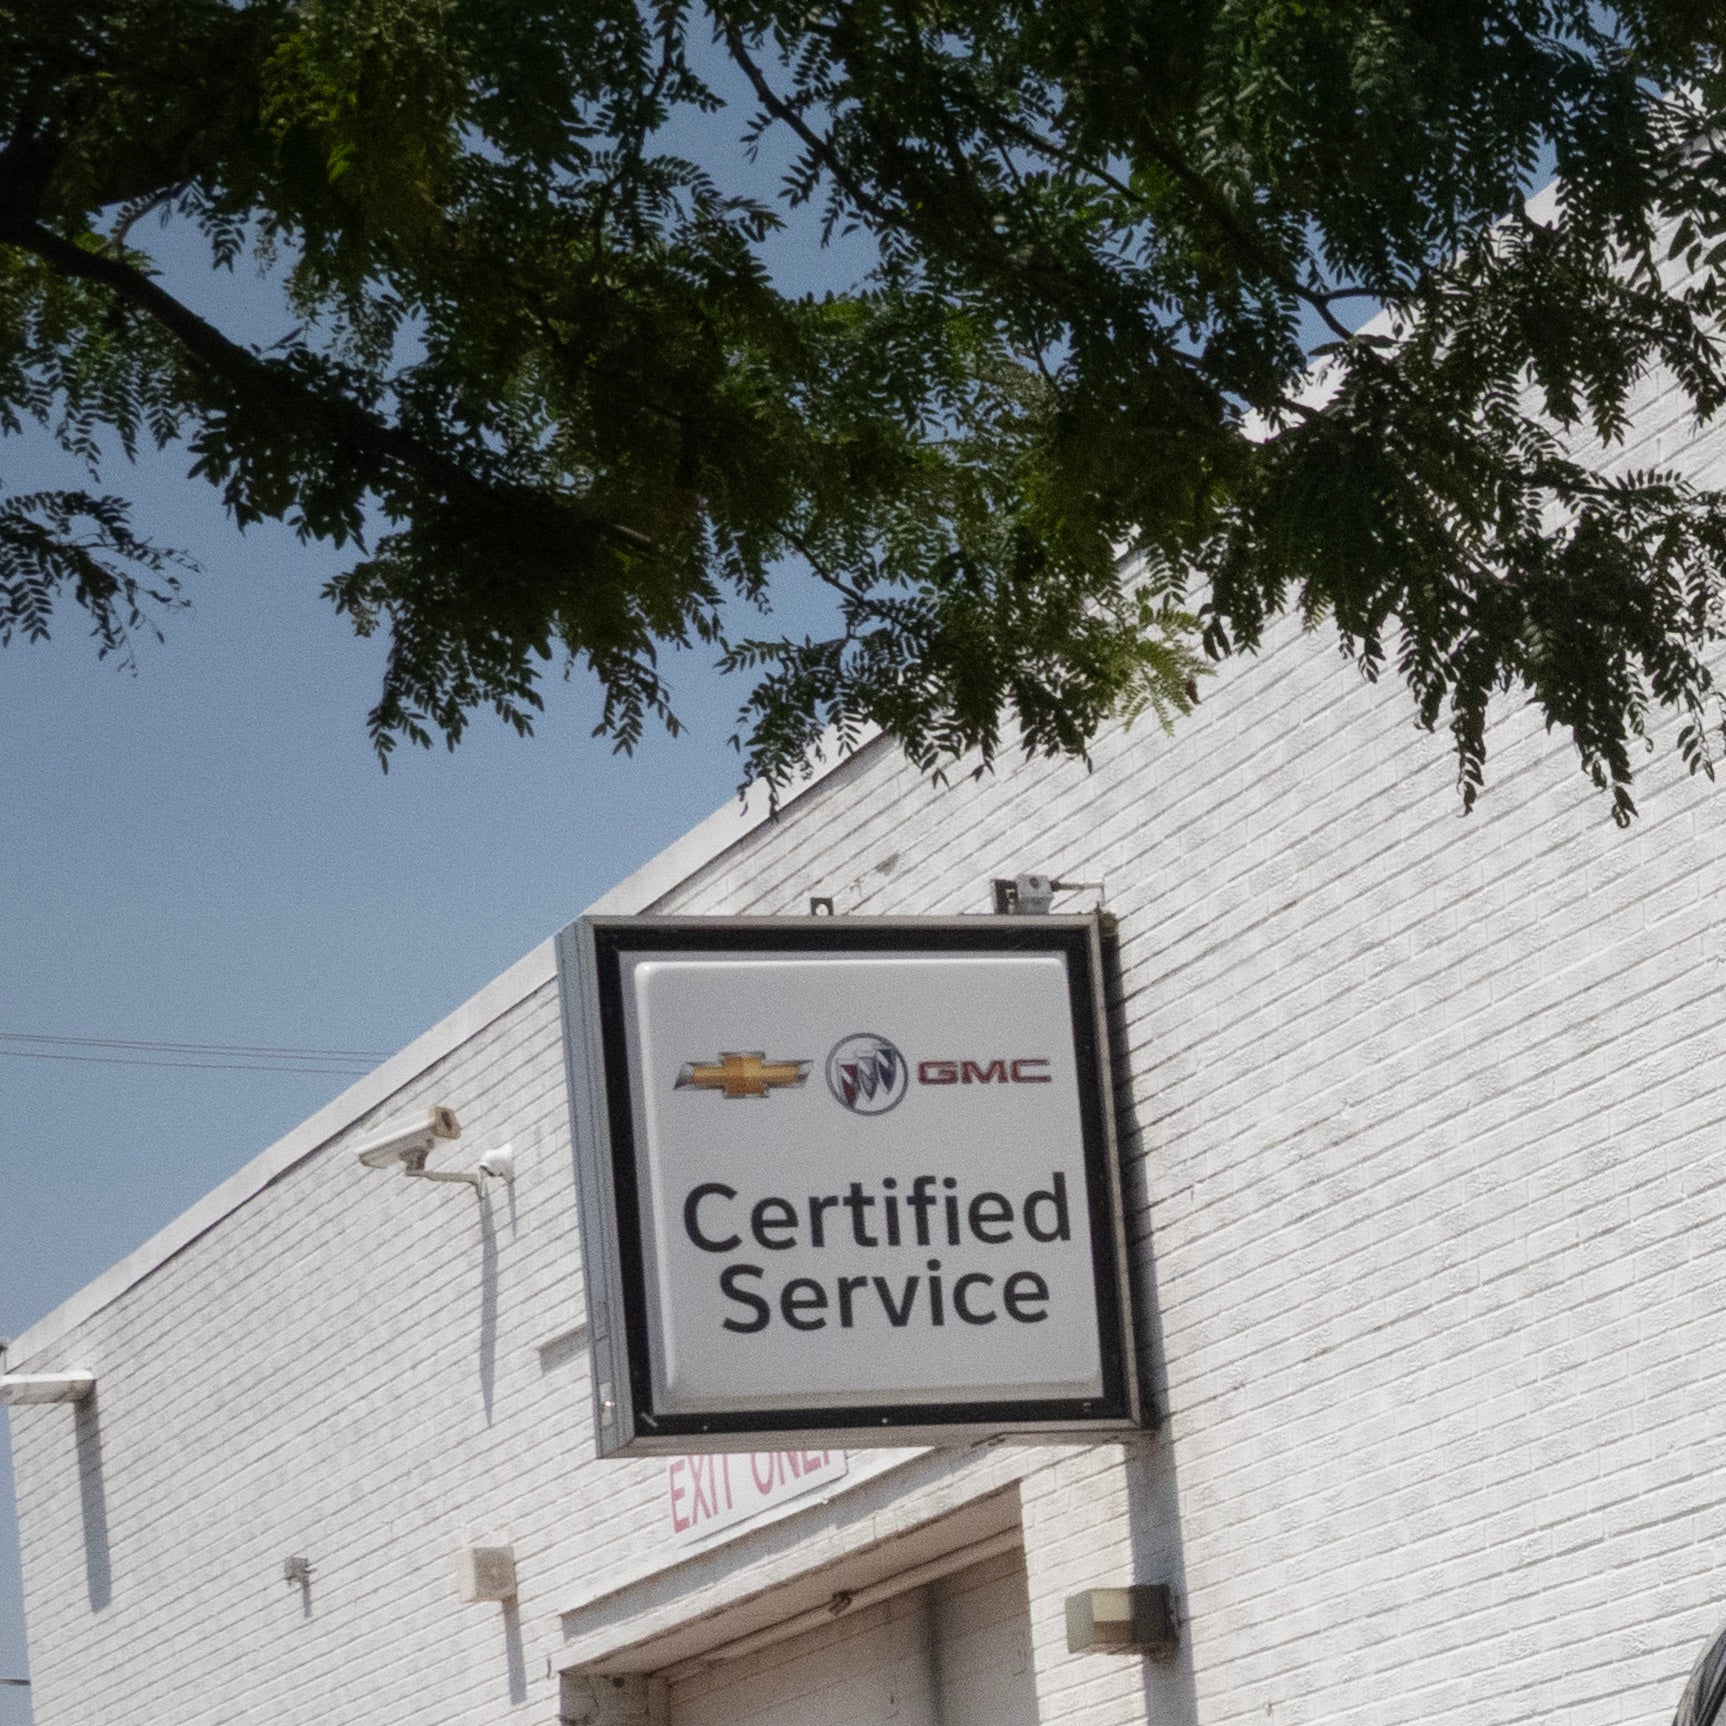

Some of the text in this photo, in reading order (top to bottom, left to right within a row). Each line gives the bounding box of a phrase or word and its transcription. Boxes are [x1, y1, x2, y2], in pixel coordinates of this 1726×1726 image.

[916, 1058, 1054, 1086] GMC
[683, 1171, 1073, 1254] Certified
[718, 1259, 1051, 1335] Service
[669, 1454, 733, 1534] EXIT
